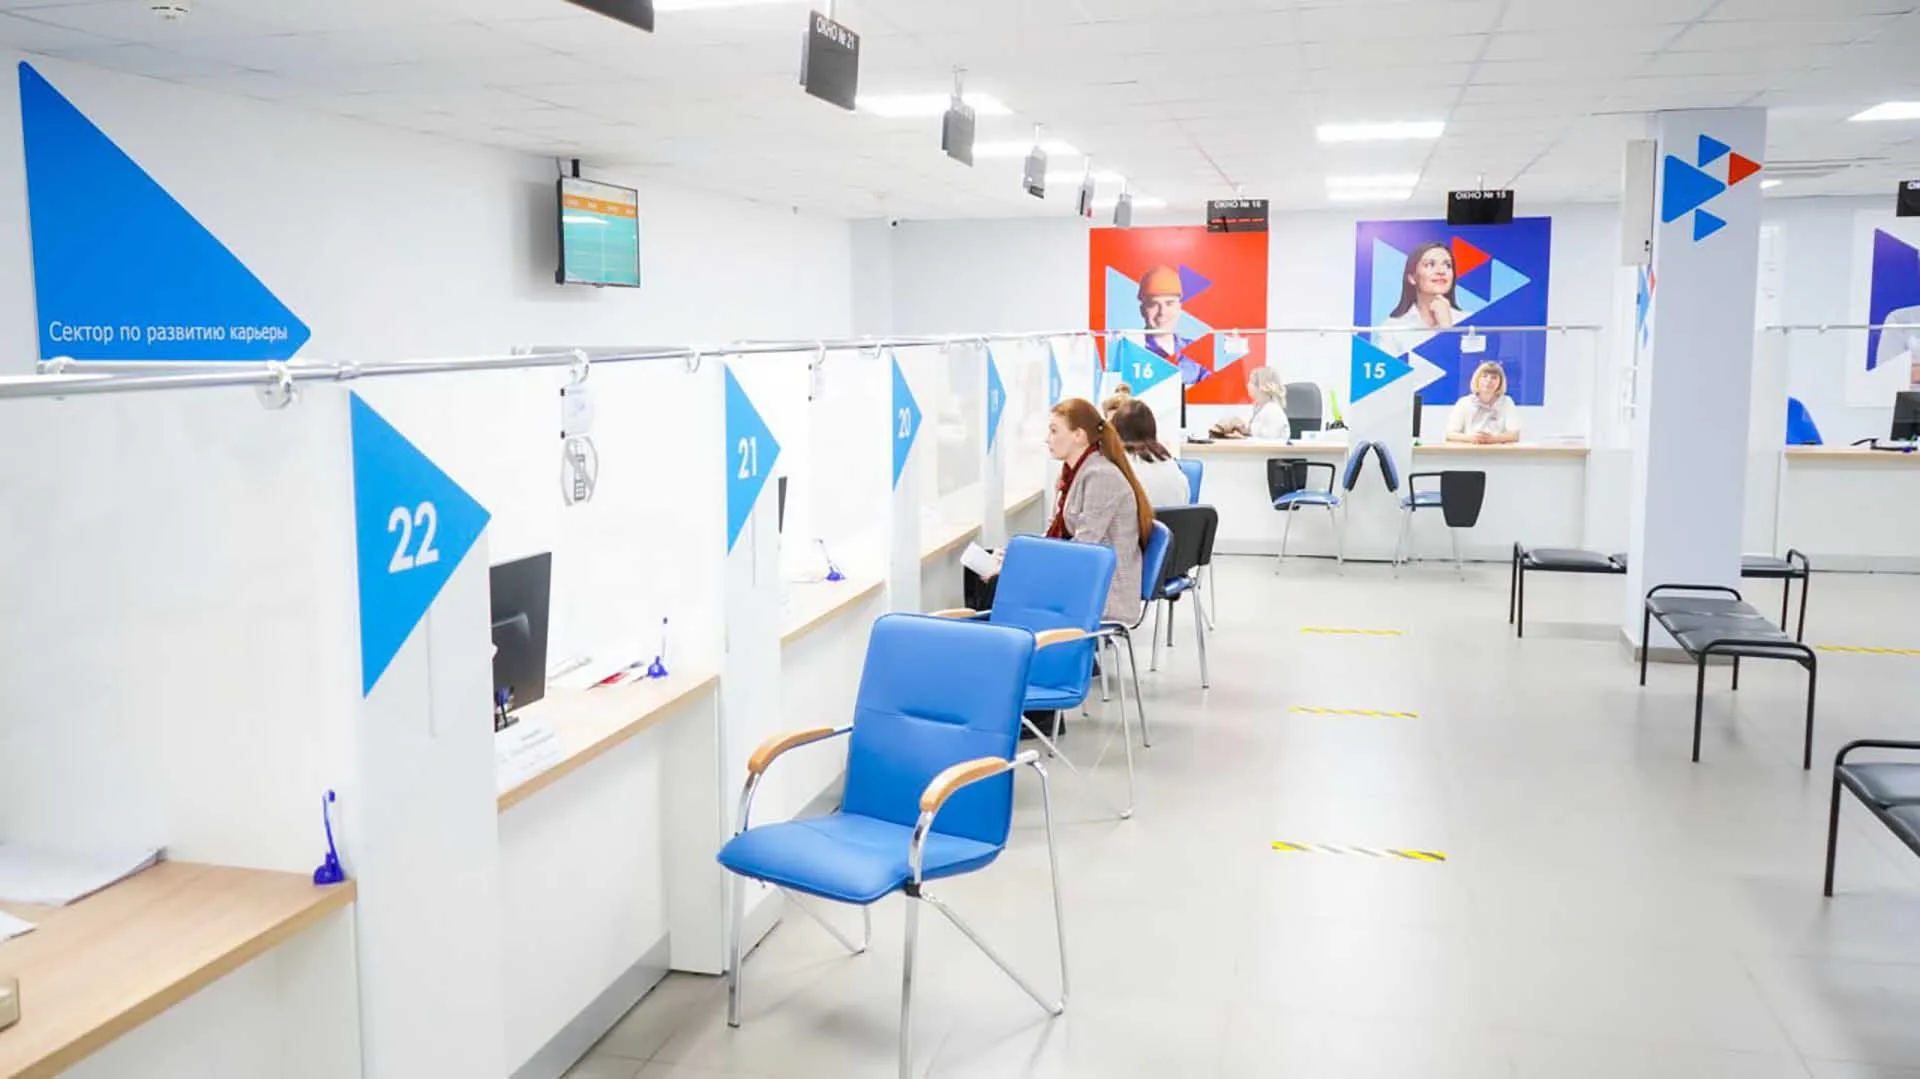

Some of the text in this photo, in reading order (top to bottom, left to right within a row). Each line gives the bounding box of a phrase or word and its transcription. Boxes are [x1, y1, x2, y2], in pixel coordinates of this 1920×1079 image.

[815, 16, 838, 42] ОКНО
[847, 31, 855, 49] 21
[1214, 200, 1239, 208] ОКНО
[1455, 191, 1482, 200] ОКНО
[49, 320, 289, 345] Сектор по развитию карьеры
[1132, 362, 1154, 379] 16
[1363, 362, 1387, 379] 15
[898, 407, 912, 439] 20
[737, 436, 758, 481] 21
[387, 500, 440, 574] 22
